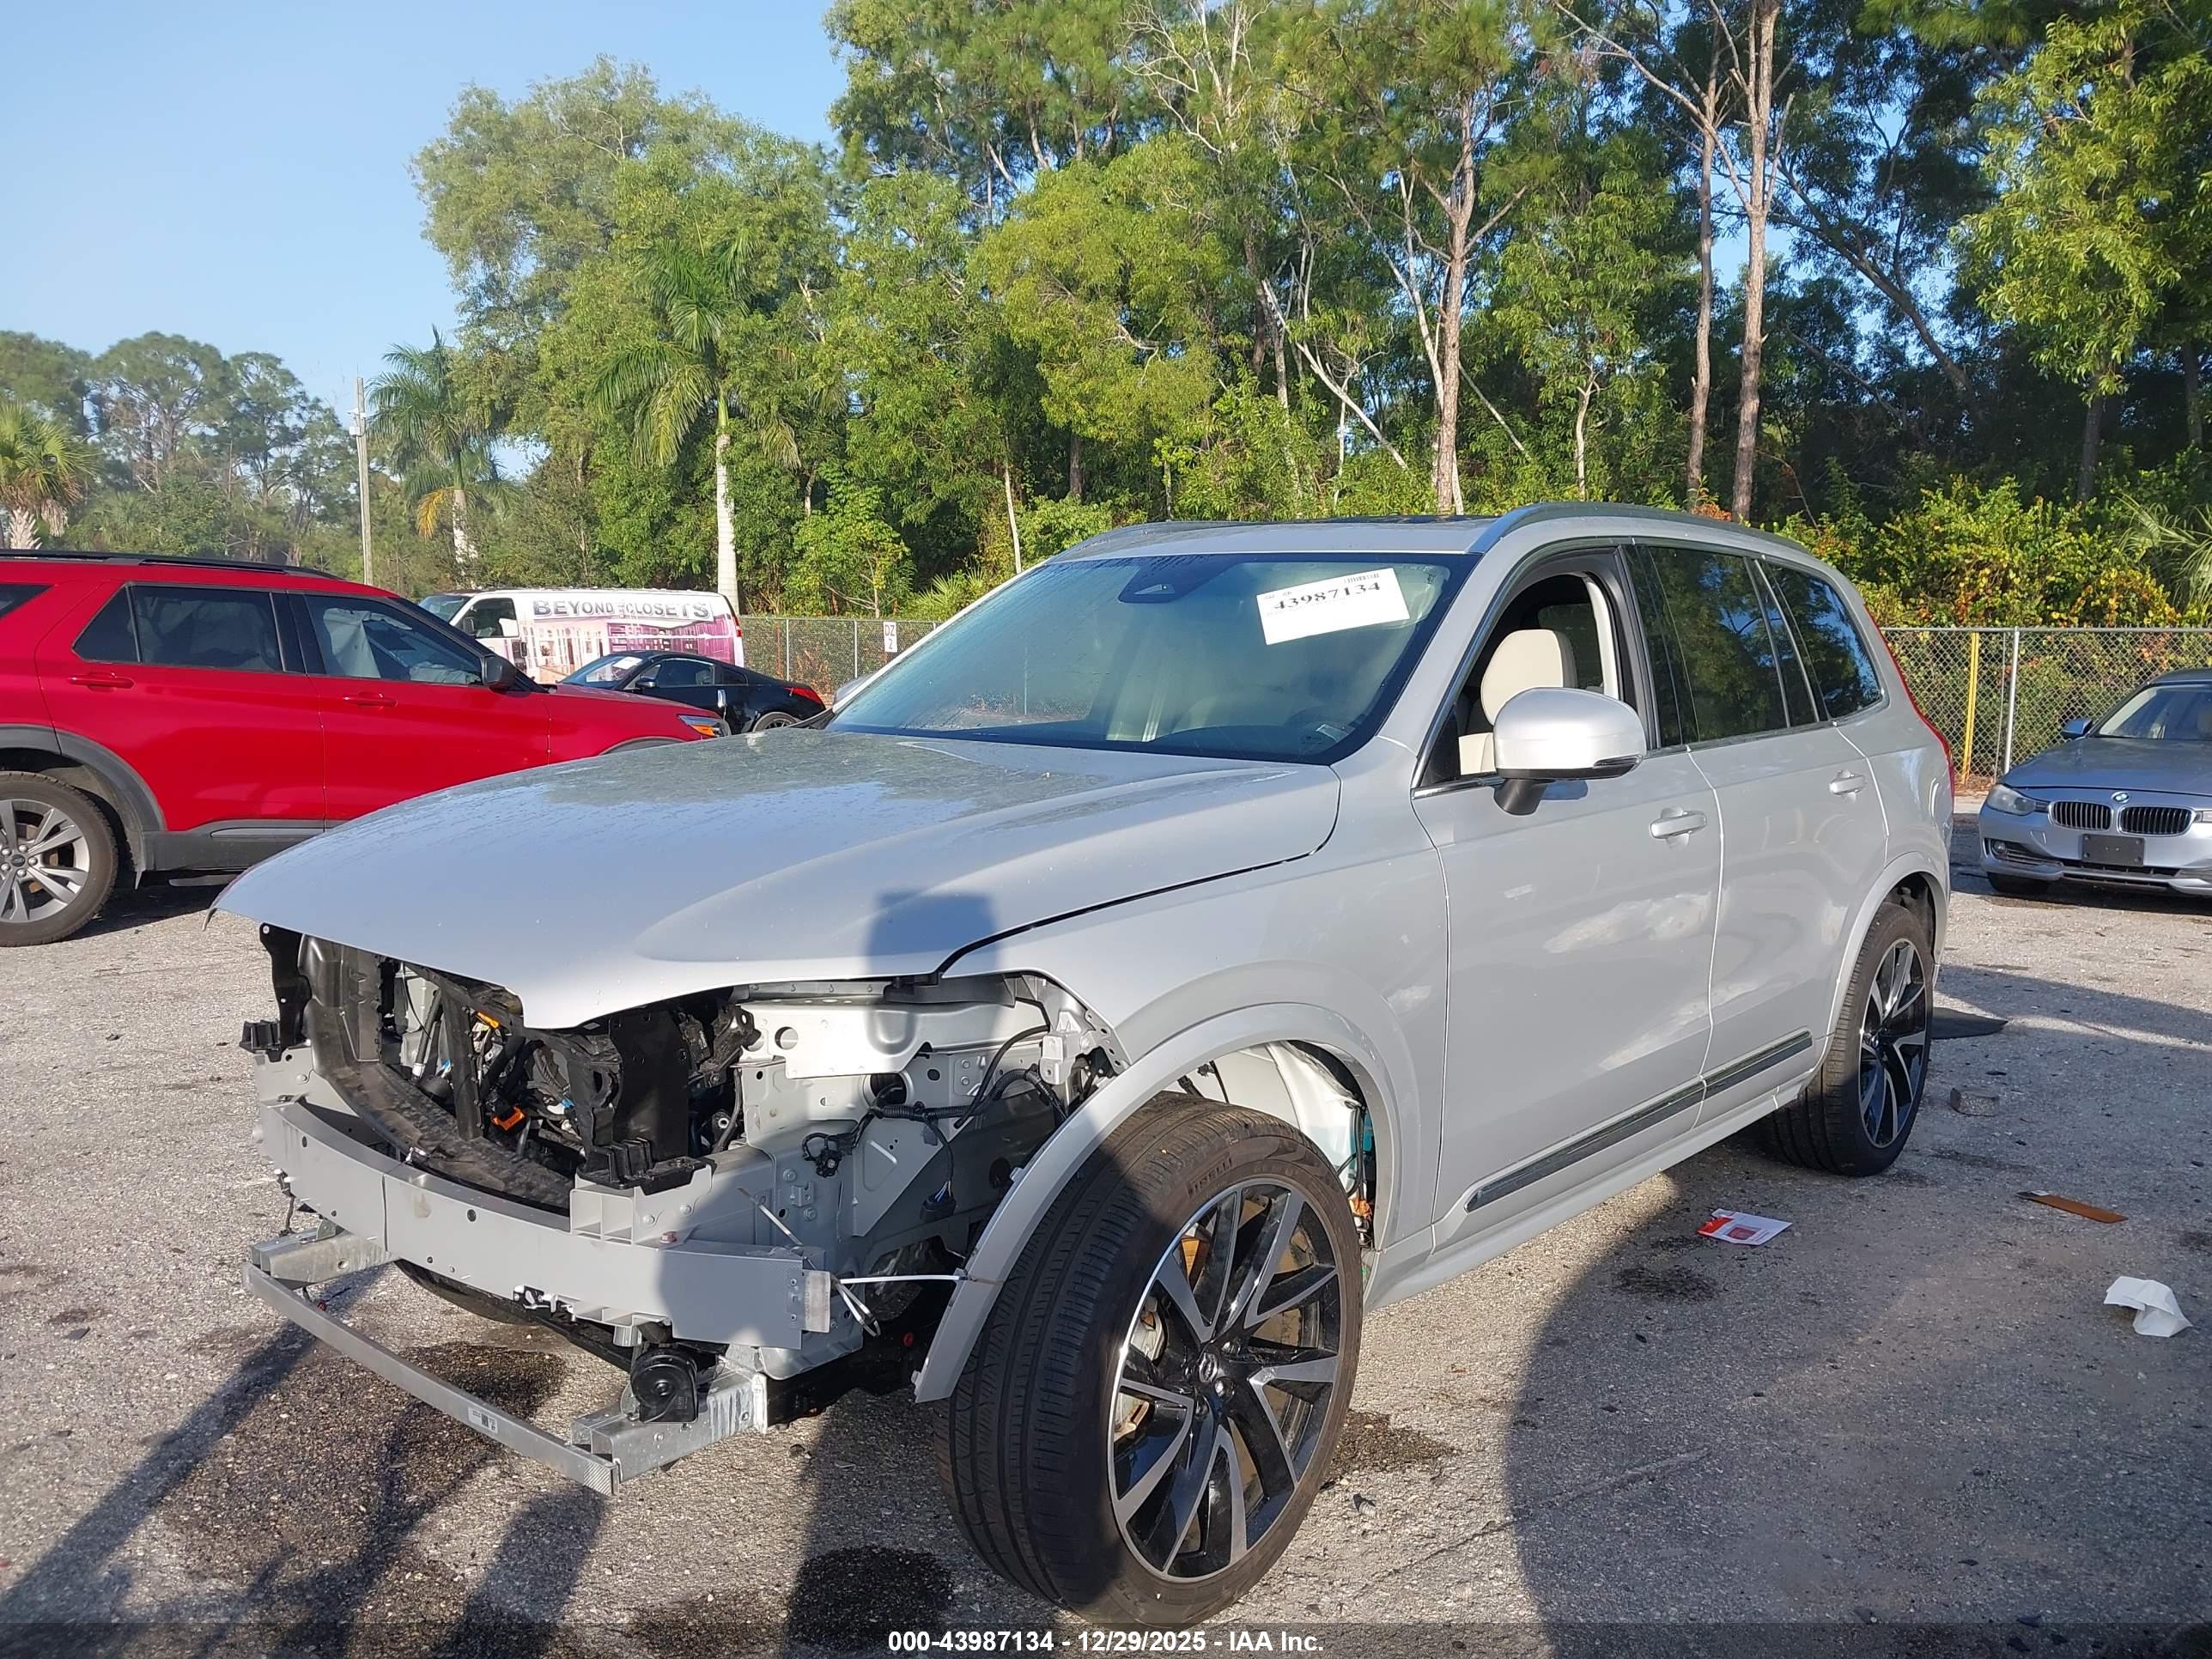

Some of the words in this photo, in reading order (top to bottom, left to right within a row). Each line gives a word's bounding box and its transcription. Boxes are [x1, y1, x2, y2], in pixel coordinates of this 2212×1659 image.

[1273, 581, 1381, 610] 43987134
[533, 599, 614, 616] BEYOND
[625, 601, 710, 619] CLOSETS
[884, 624, 896, 636] DZ
[888, 638, 894, 650] 2
